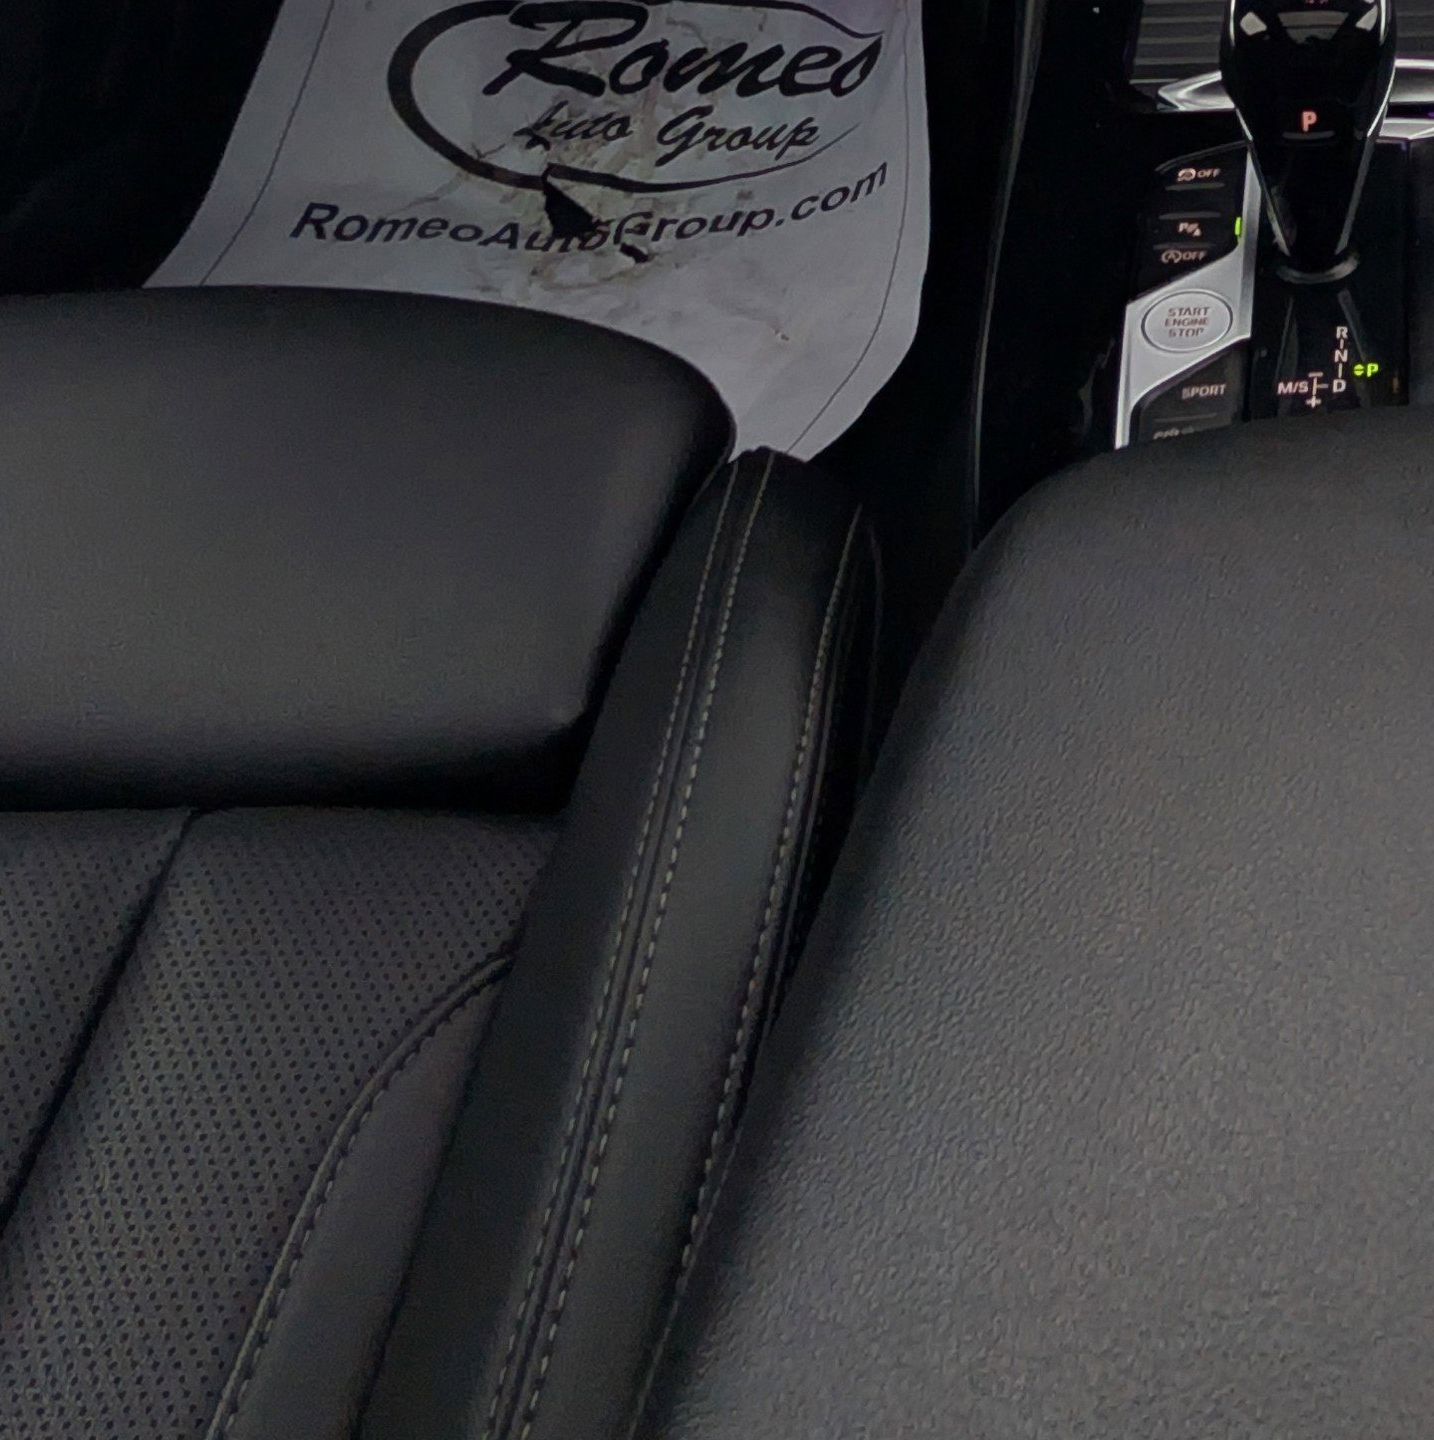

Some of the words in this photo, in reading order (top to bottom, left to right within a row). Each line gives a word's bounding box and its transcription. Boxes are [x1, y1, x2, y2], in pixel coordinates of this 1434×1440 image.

[1303, 111, 1317, 132] P
[654, 105, 821, 167] Group
[1168, 306, 1210, 317] START
[1164, 317, 1210, 327] ENGINE
[1168, 327, 1205, 338] STOP
[1336, 326, 1349, 340] R
[1334, 349, 1349, 363] N
[1366, 364, 1379, 378] P
[1182, 384, 1226, 399] SPORT
[1277, 382, 1309, 396] M/S
[1333, 379, 1347, 393] D
